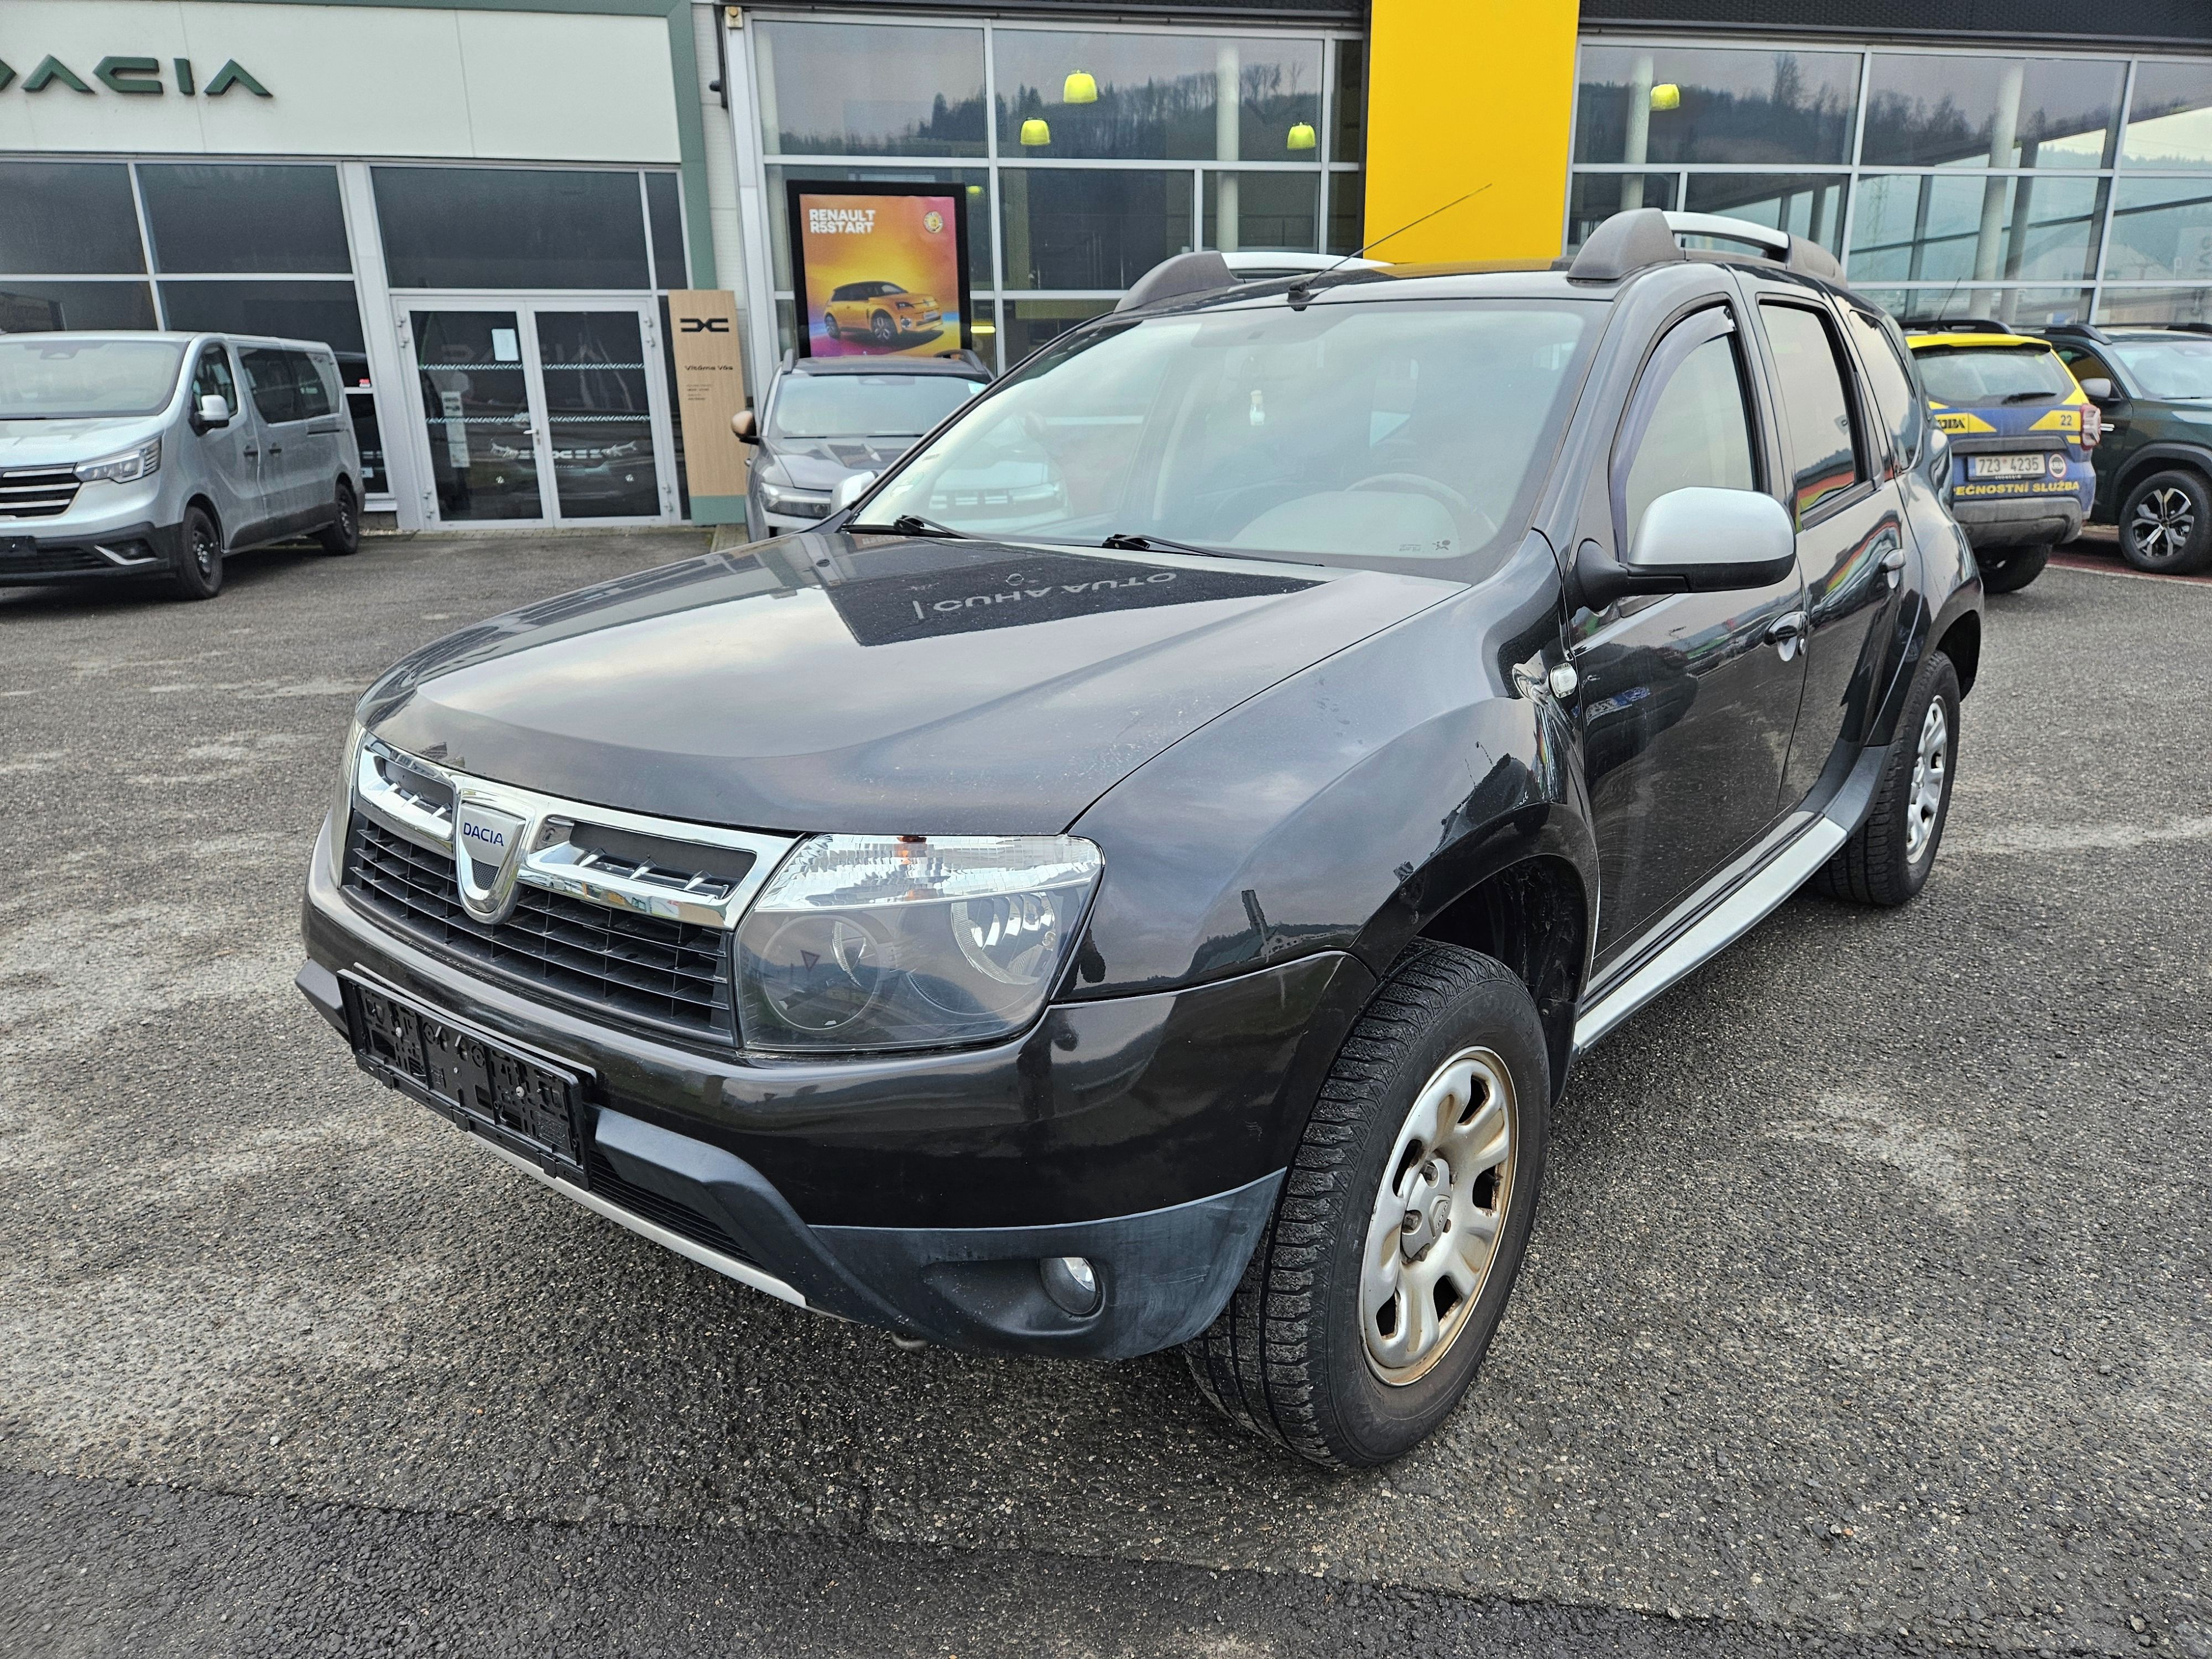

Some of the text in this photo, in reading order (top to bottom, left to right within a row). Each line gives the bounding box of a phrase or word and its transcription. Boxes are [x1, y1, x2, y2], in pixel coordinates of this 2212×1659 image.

[0, 54, 273, 97] ACIA
[809, 208, 876, 221] RENAULT
[810, 221, 875, 234] R5START
[2061, 415, 2072, 426] 22
[2011, 457, 2039, 472] 4235
[1953, 480, 2079, 495] EČNOSTNÍ SLUŽBA
[463, 822, 504, 847] DACIA
